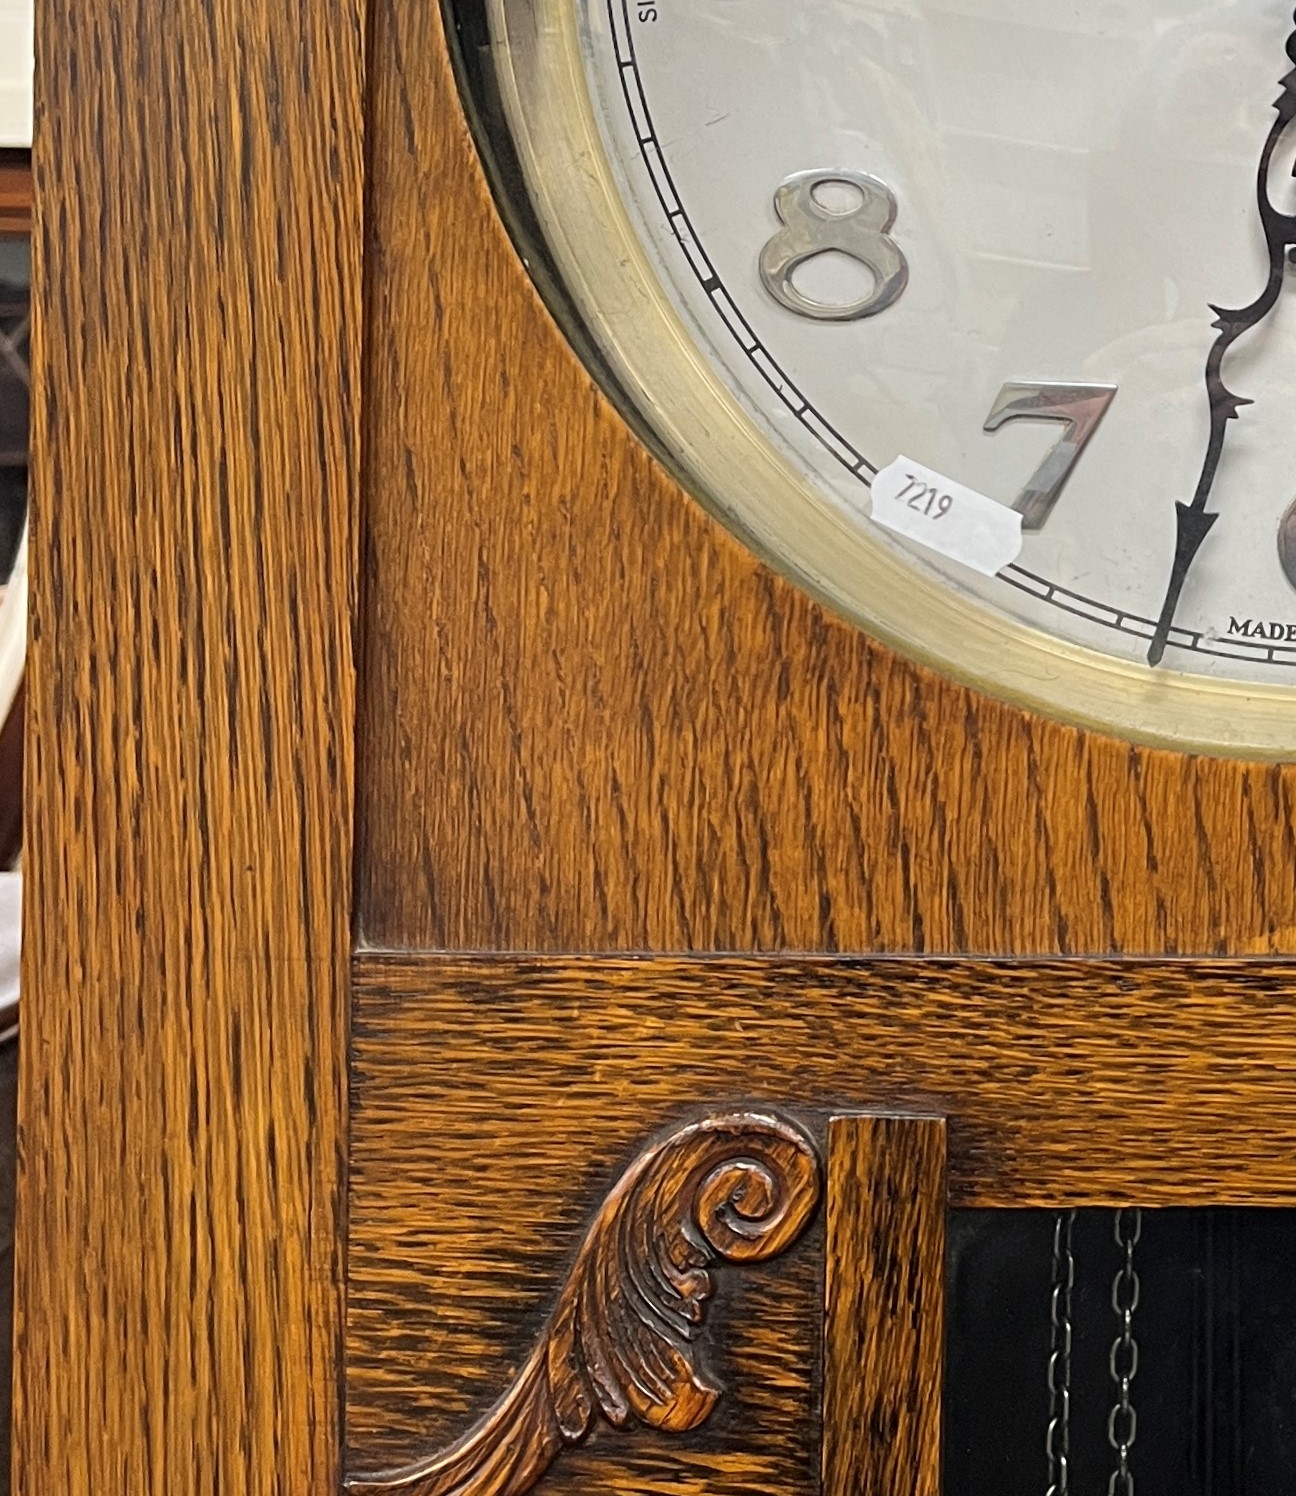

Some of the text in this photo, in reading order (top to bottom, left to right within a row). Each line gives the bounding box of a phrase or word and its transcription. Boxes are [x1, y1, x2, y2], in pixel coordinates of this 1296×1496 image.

[758, 168, 910, 321] 8
[894, 473, 953, 520] 7219
[983, 382, 1118, 530] 7
